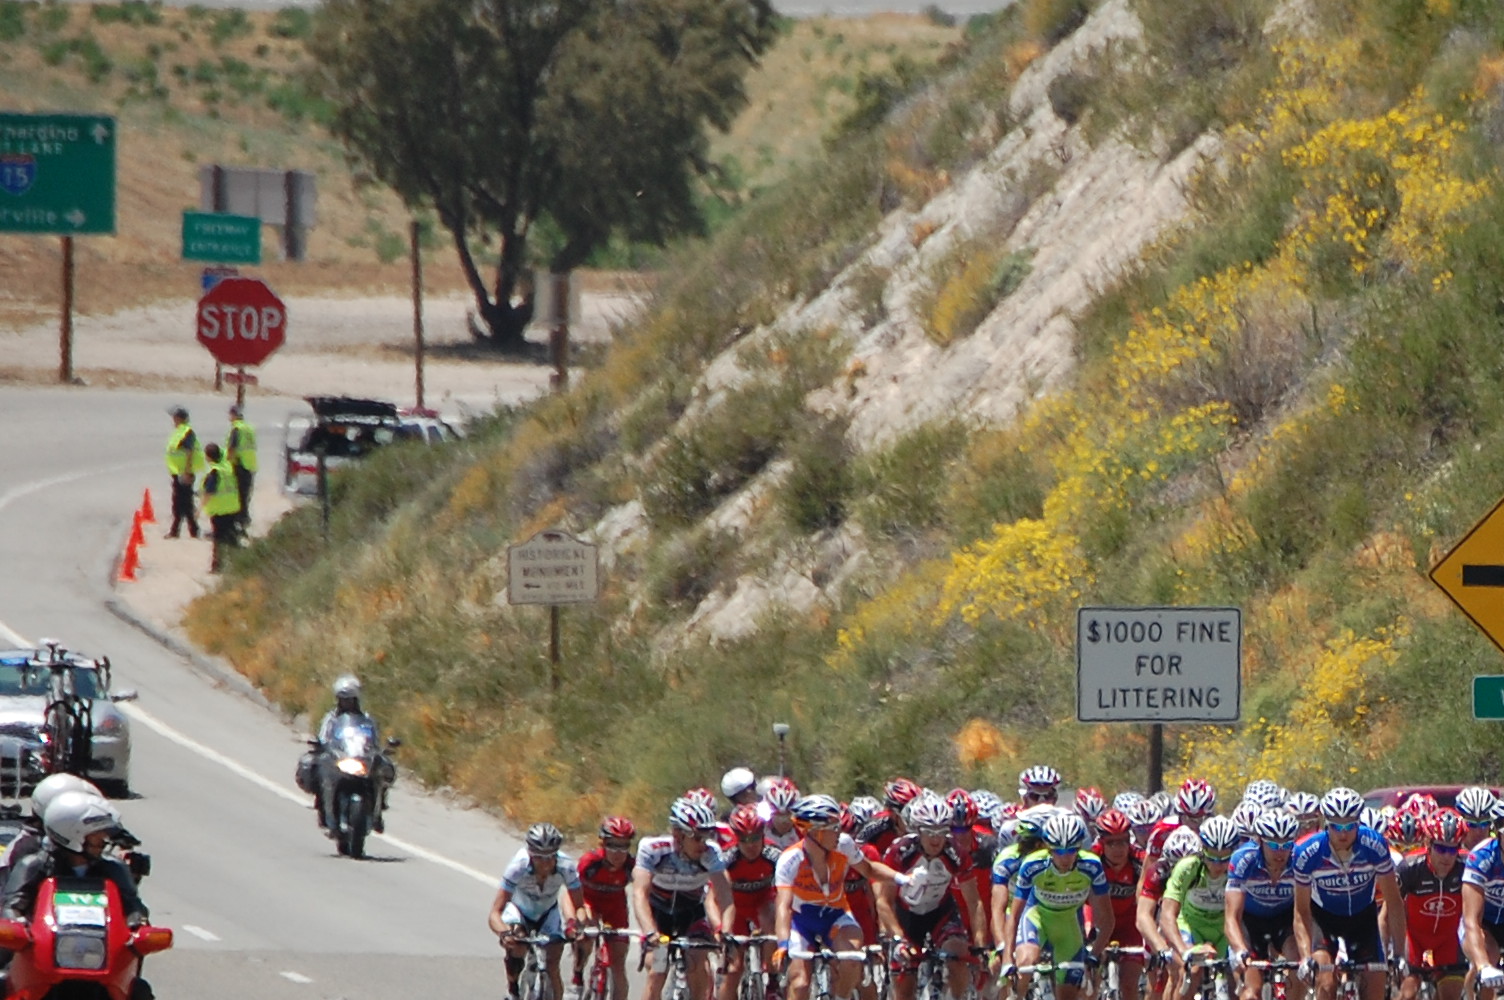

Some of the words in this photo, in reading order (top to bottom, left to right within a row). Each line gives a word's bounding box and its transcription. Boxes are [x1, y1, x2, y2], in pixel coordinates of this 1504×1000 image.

[201, 306, 281, 340] STOP
[1087, 619, 1163, 644] $1000
[1176, 621, 1232, 643] FINE
[1135, 655, 1183, 676] FOR
[1098, 687, 1220, 709] LITTERING
